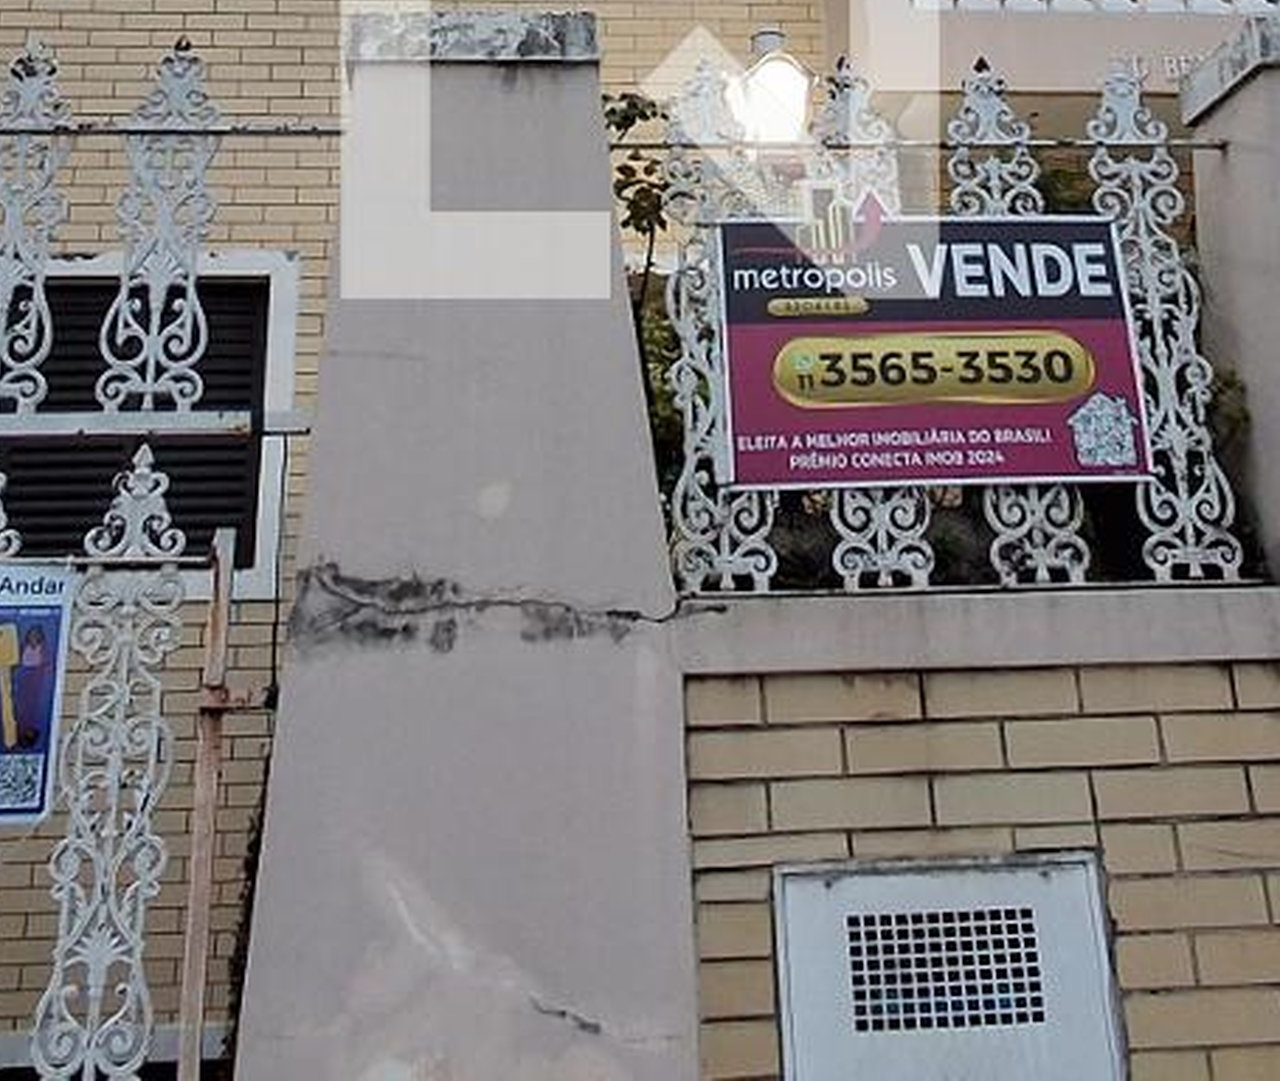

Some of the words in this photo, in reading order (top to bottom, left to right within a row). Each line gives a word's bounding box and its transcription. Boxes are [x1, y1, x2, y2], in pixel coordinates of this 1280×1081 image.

[733, 261, 898, 294] metropolis
[907, 241, 1113, 298] VENDE
[819, 349, 1074, 388] 3565-3530
[737, 434, 788, 451] ELEITA
[791, 434, 803, 449] A
[806, 432, 870, 448] MELHOR
[968, 430, 991, 444] DO
[851, 451, 923, 469] CONECTA
[924, 451, 963, 466] IMOB
[966, 449, 1005, 465] 2024
